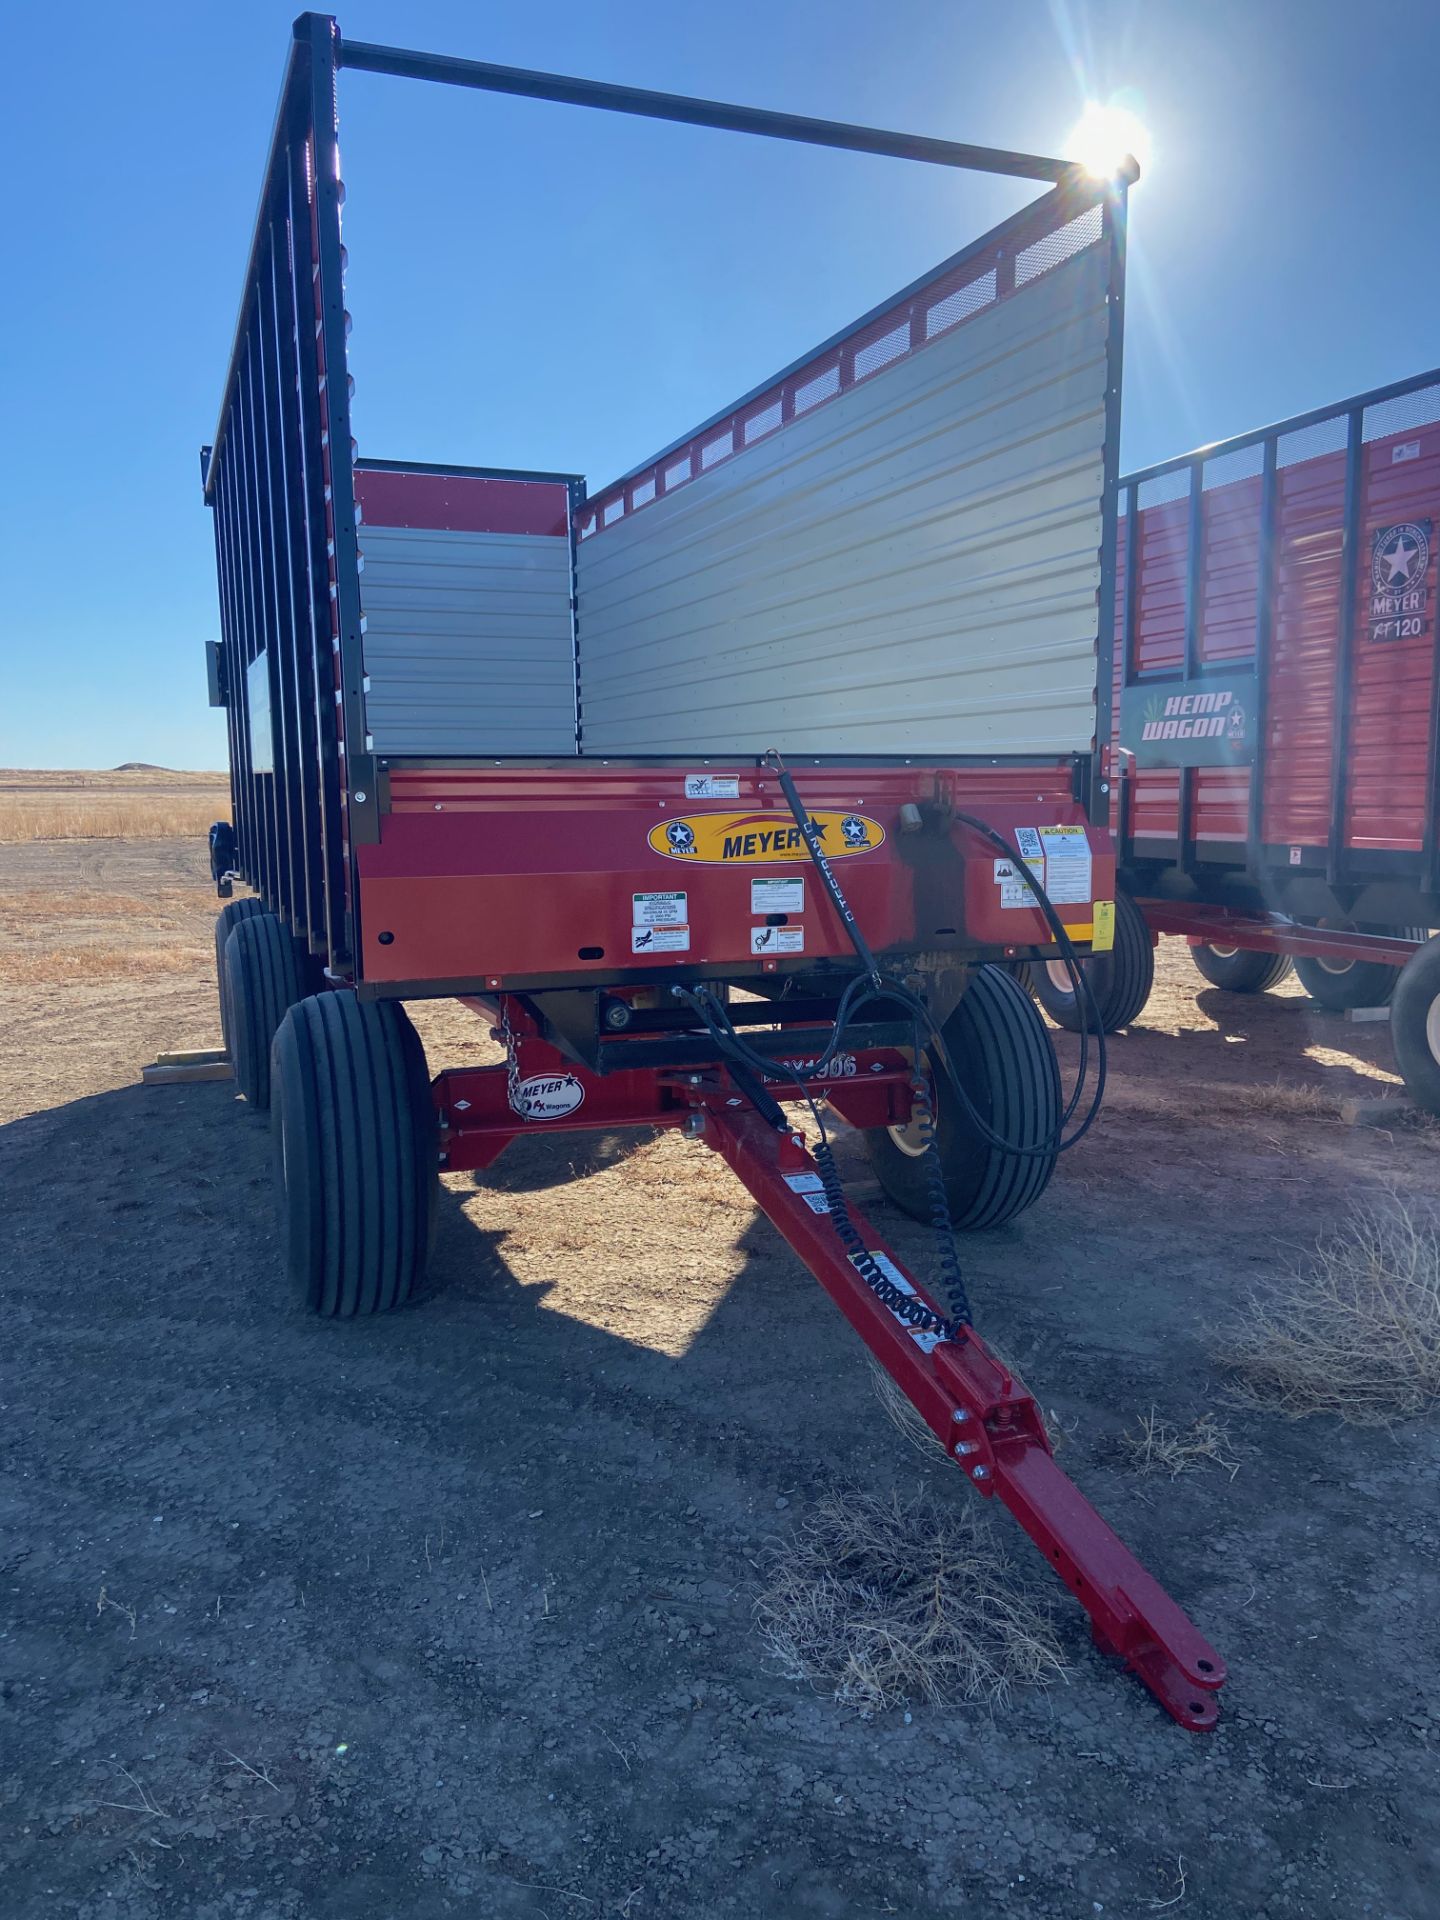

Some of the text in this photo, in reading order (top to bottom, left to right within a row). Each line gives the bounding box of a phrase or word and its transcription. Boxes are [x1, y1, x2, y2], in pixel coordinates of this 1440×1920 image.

[1373, 591, 1420, 616] MEYER
[1394, 617, 1421, 637] 120
[1164, 691, 1233, 717] HEMP
[1142, 717, 1226, 741] WAGON
[723, 828, 800, 859] MEYER
[642, 893, 677, 901] IMPORTANT
[523, 1080, 563, 1098] MEYER
[546, 1103, 572, 1111] Wagons
